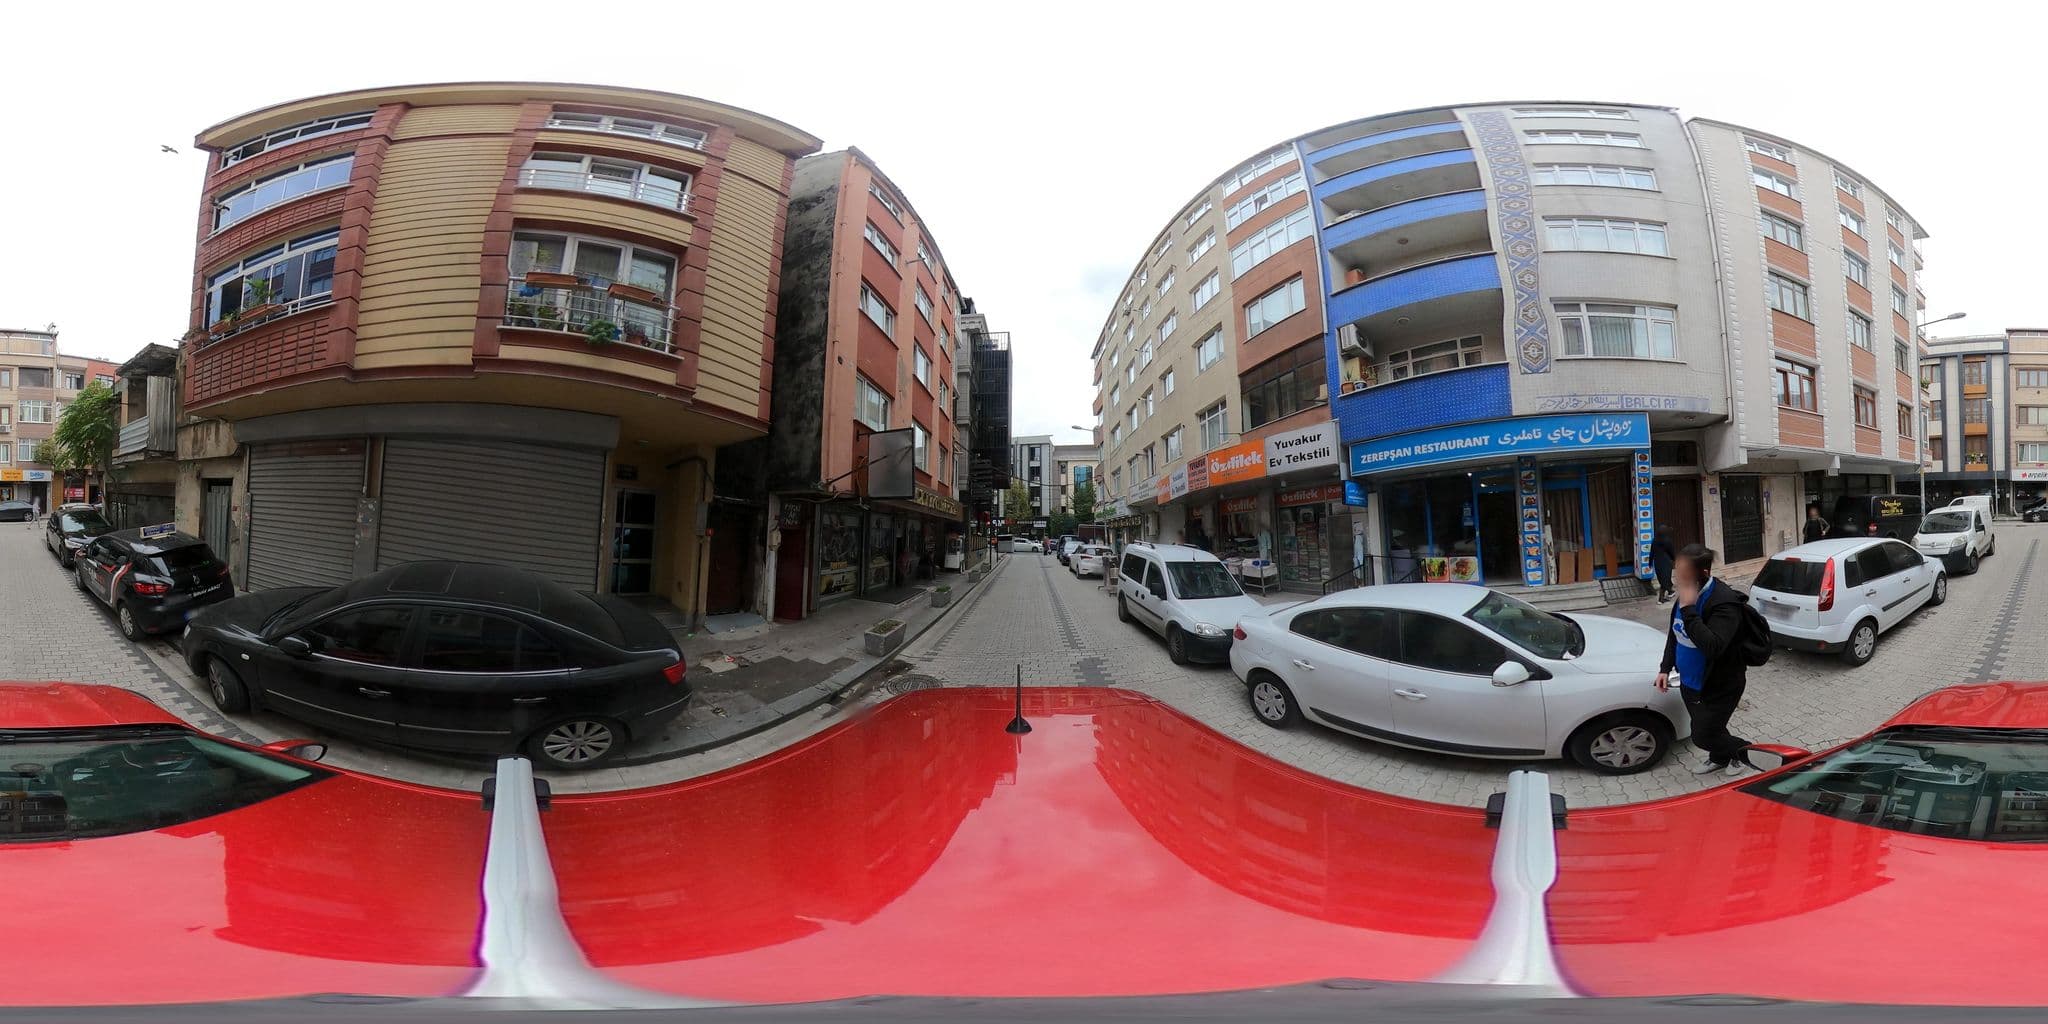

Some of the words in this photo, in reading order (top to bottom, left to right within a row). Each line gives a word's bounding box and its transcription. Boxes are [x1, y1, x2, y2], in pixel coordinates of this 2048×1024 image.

[1274, 433, 1323, 450] Yuvakur
[1360, 447, 1412, 464] ZEREPŞAN
[1414, 435, 1490, 455] RESTAURANT
[1210, 450, 1263, 474] Özdilek
[1269, 457, 1282, 468] Ev
[1285, 446, 1331, 464] Tekstili
[1281, 488, 1318, 502] Özdilek
